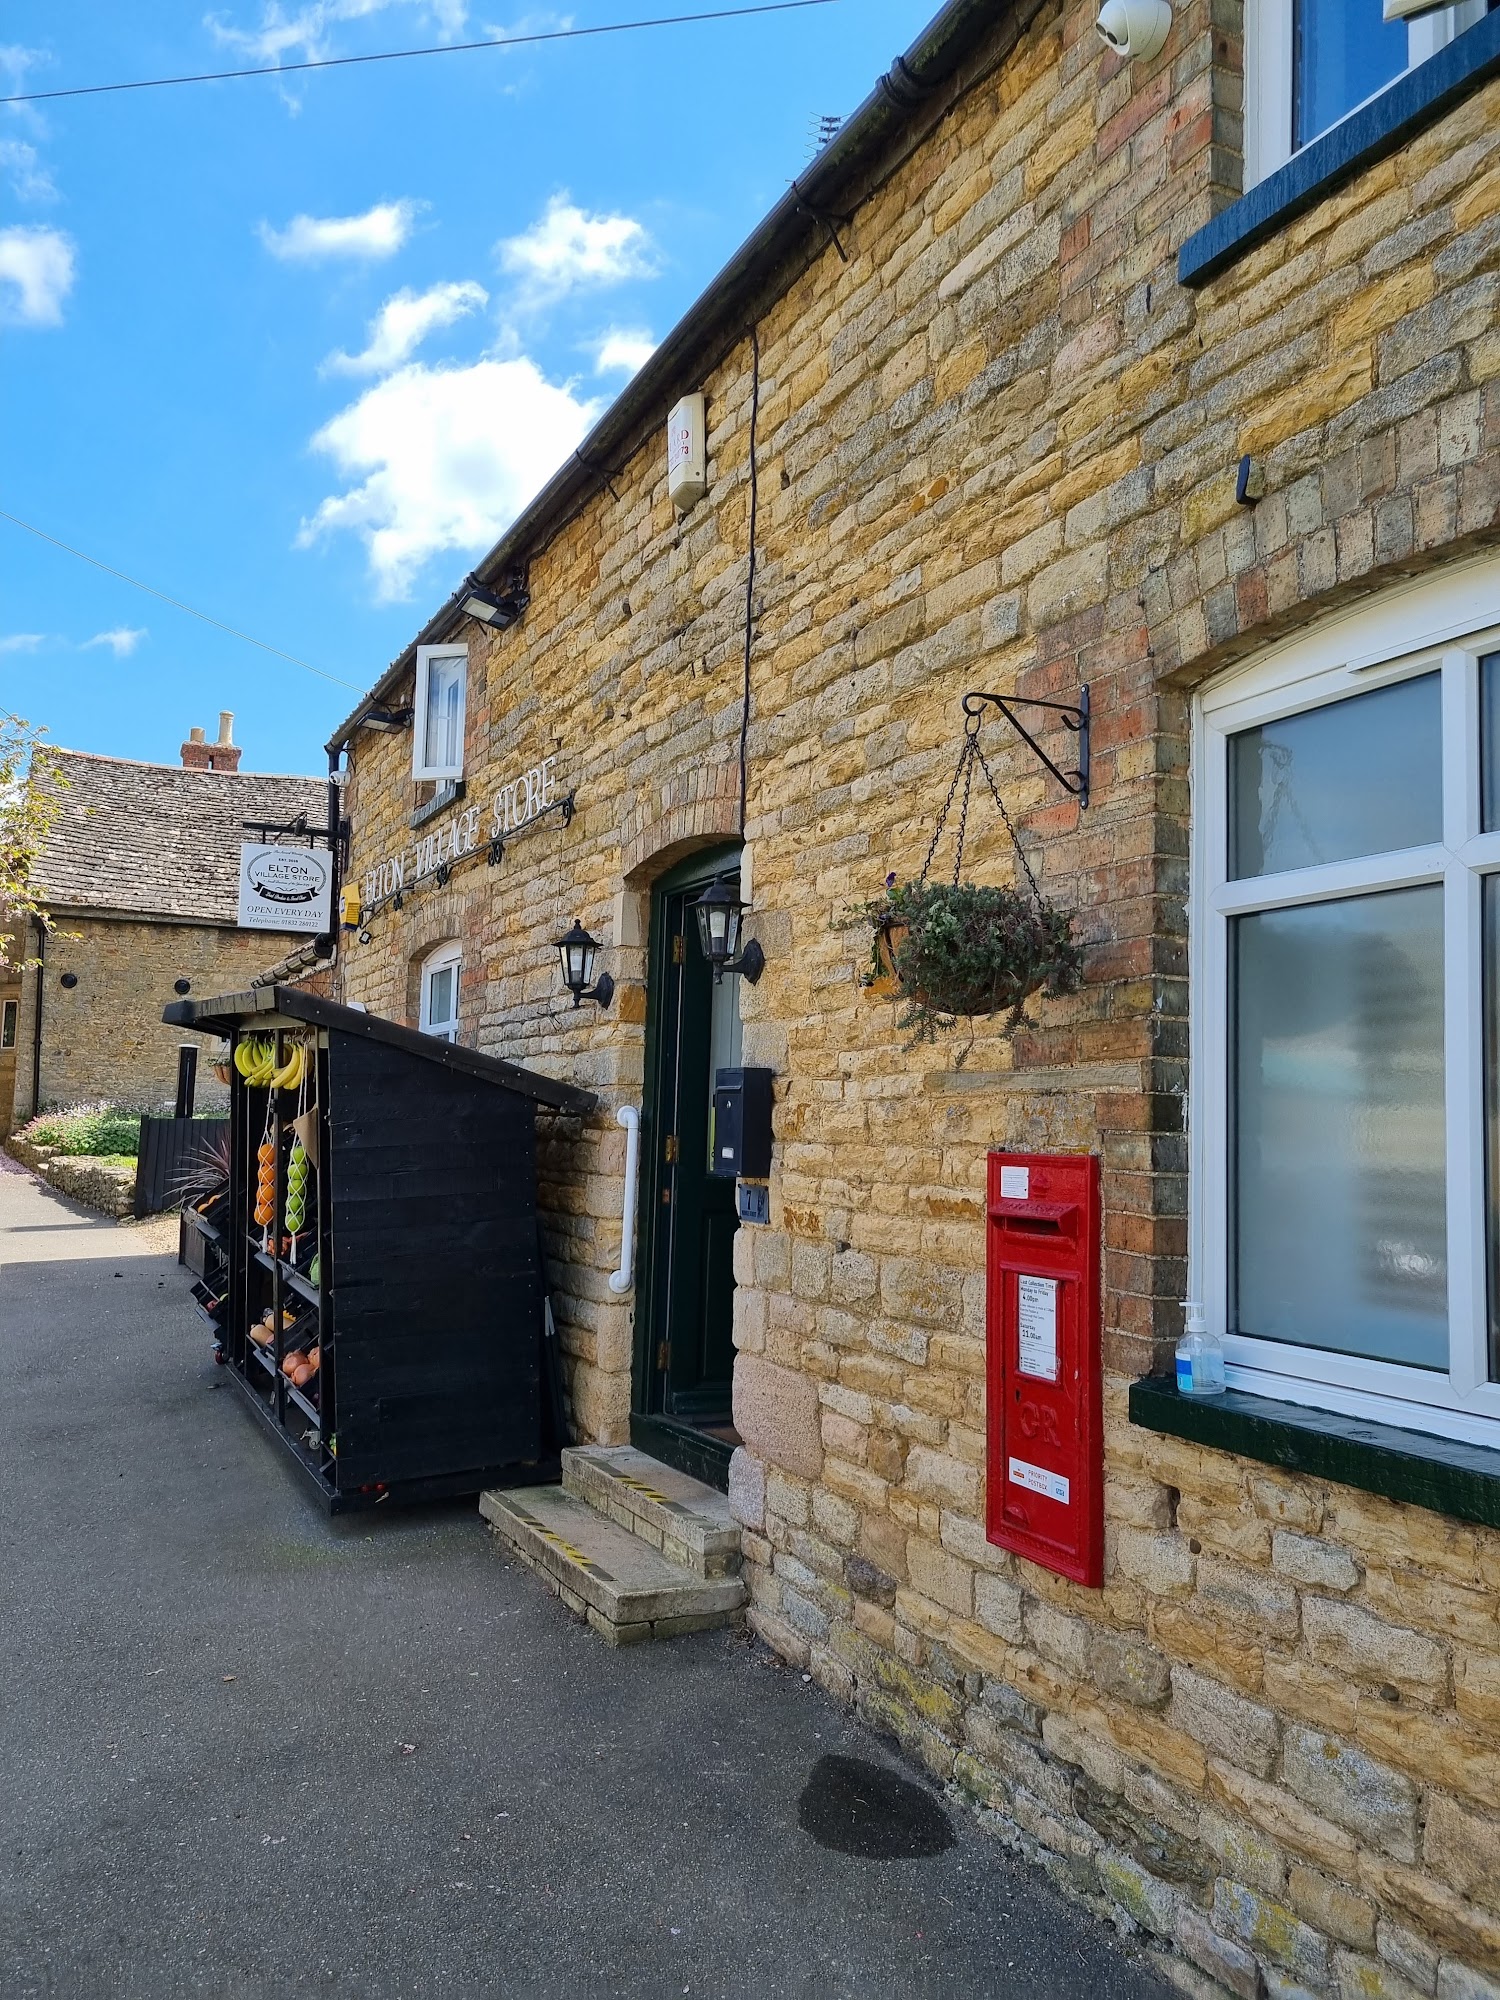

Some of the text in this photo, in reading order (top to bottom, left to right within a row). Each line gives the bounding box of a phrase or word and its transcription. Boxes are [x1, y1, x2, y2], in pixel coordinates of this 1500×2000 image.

[366, 756, 558, 905] ELTON VILLAGE STORE
[254, 870, 320, 882] VILLAGE STORE
[268, 864, 308, 875] ELTON
[246, 905, 324, 918] OPEN EVERY DAY
[1028, 1469, 1048, 1482] PRIORITY
[1028, 1478, 1048, 1491] POSTBOX
